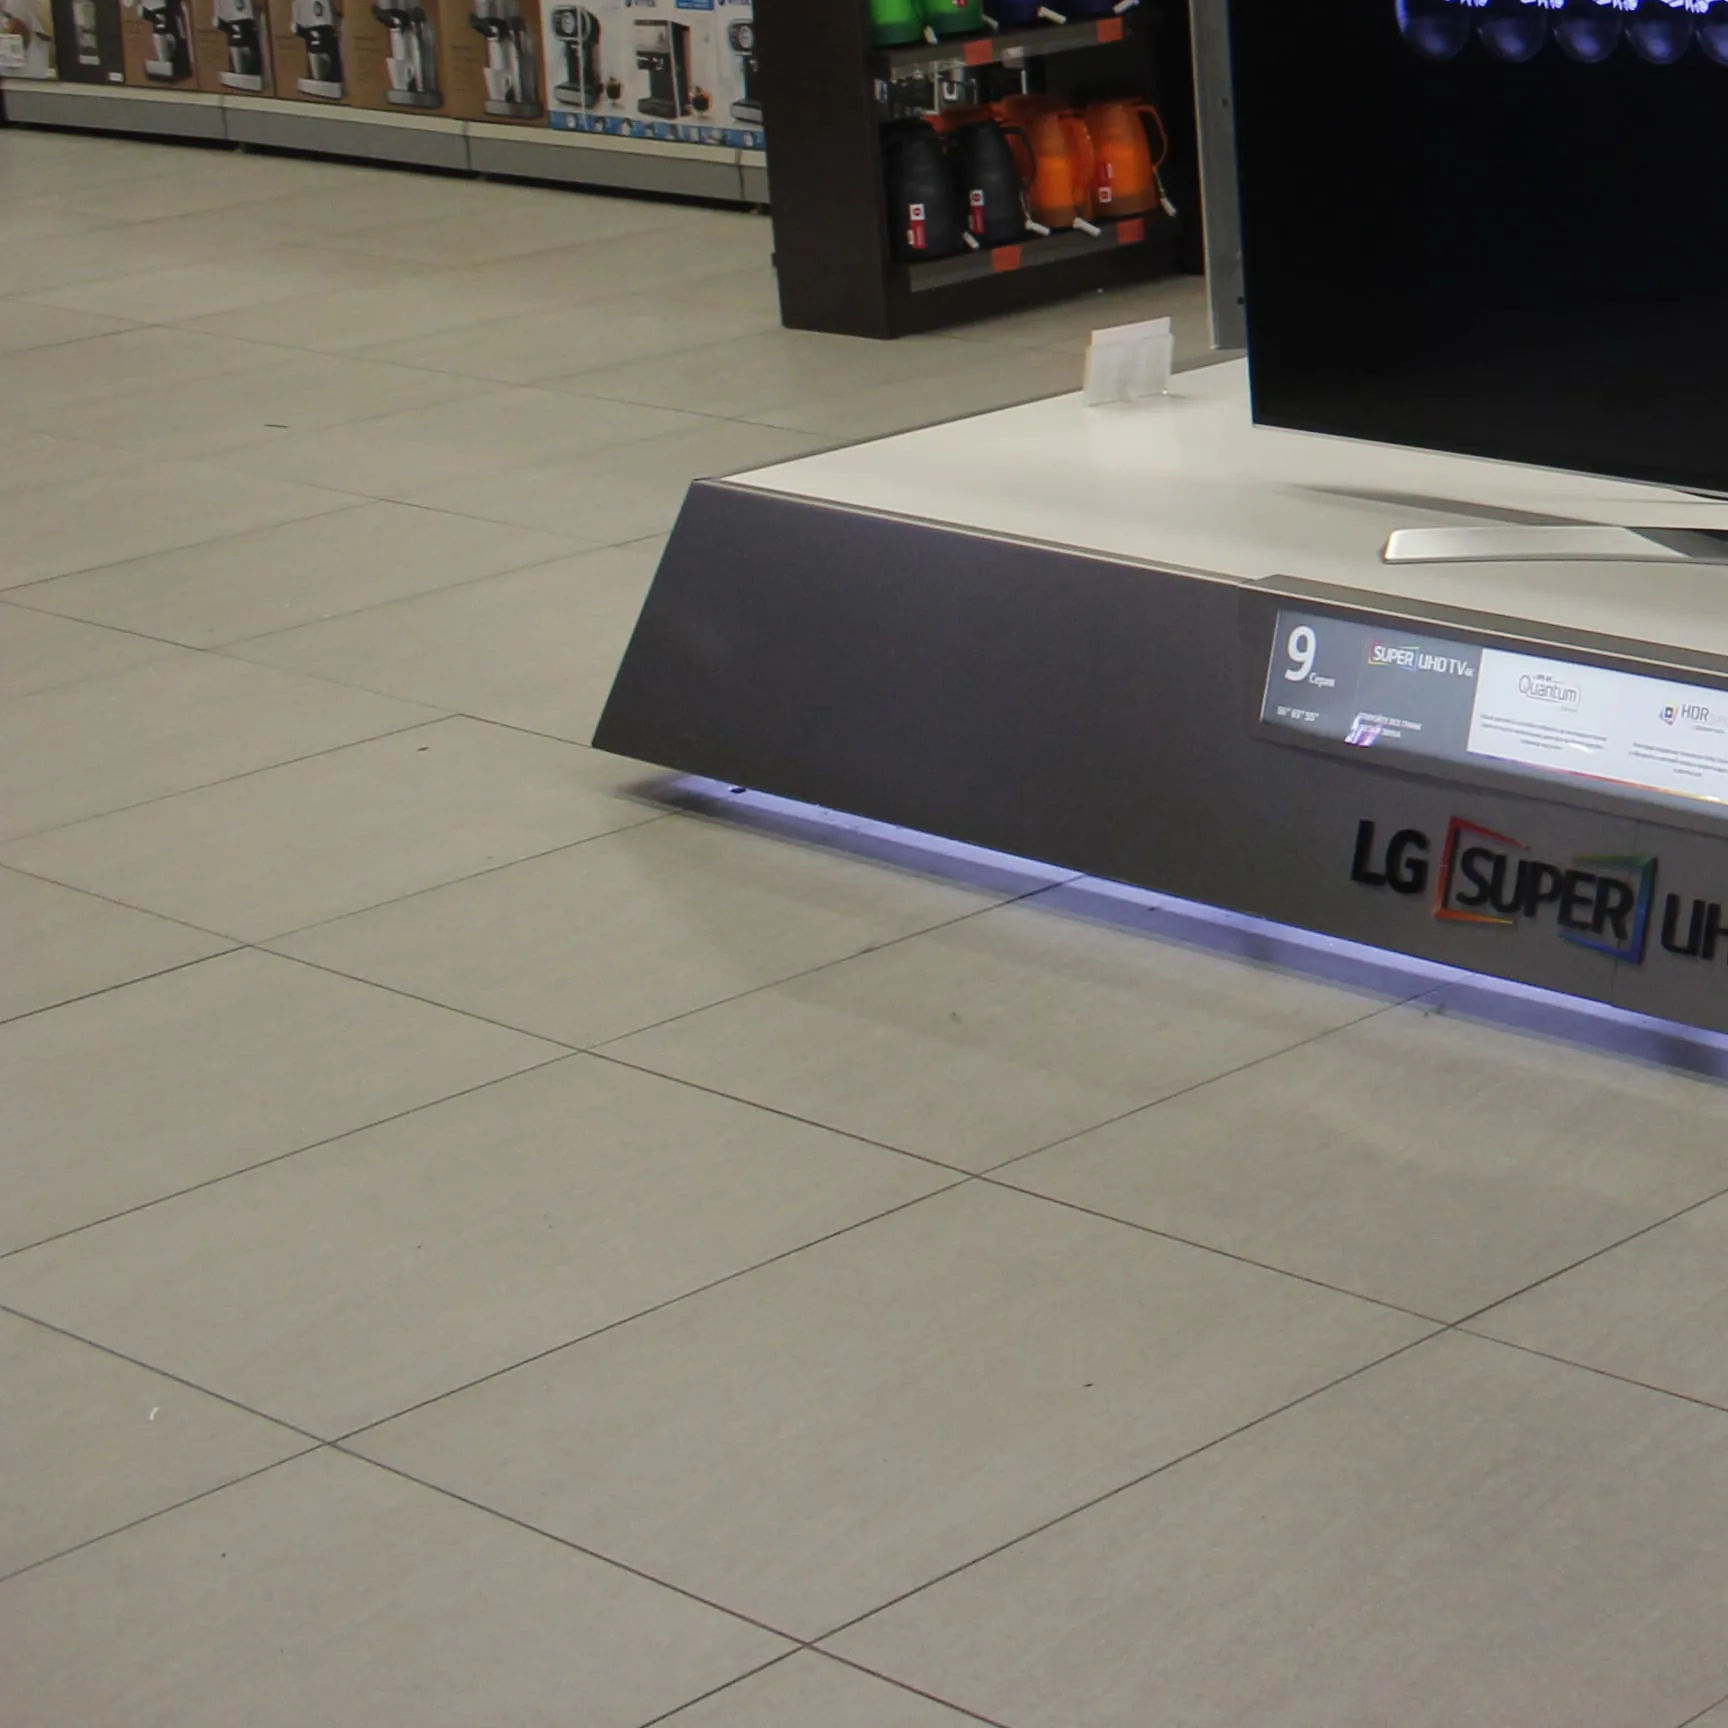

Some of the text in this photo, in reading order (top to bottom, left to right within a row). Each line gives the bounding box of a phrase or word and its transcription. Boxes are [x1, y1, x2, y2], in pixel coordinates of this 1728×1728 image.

[1284, 625, 1317, 682] 9
[1373, 645, 1414, 667] SUPER
[1419, 653, 1447, 672] UHD
[1448, 658, 1467, 676] TV
[1519, 674, 1577, 703] Quantum
[1681, 704, 1710, 722] HDR
[1351, 819, 1430, 894] LG
[1455, 846, 1636, 940] SUPER
